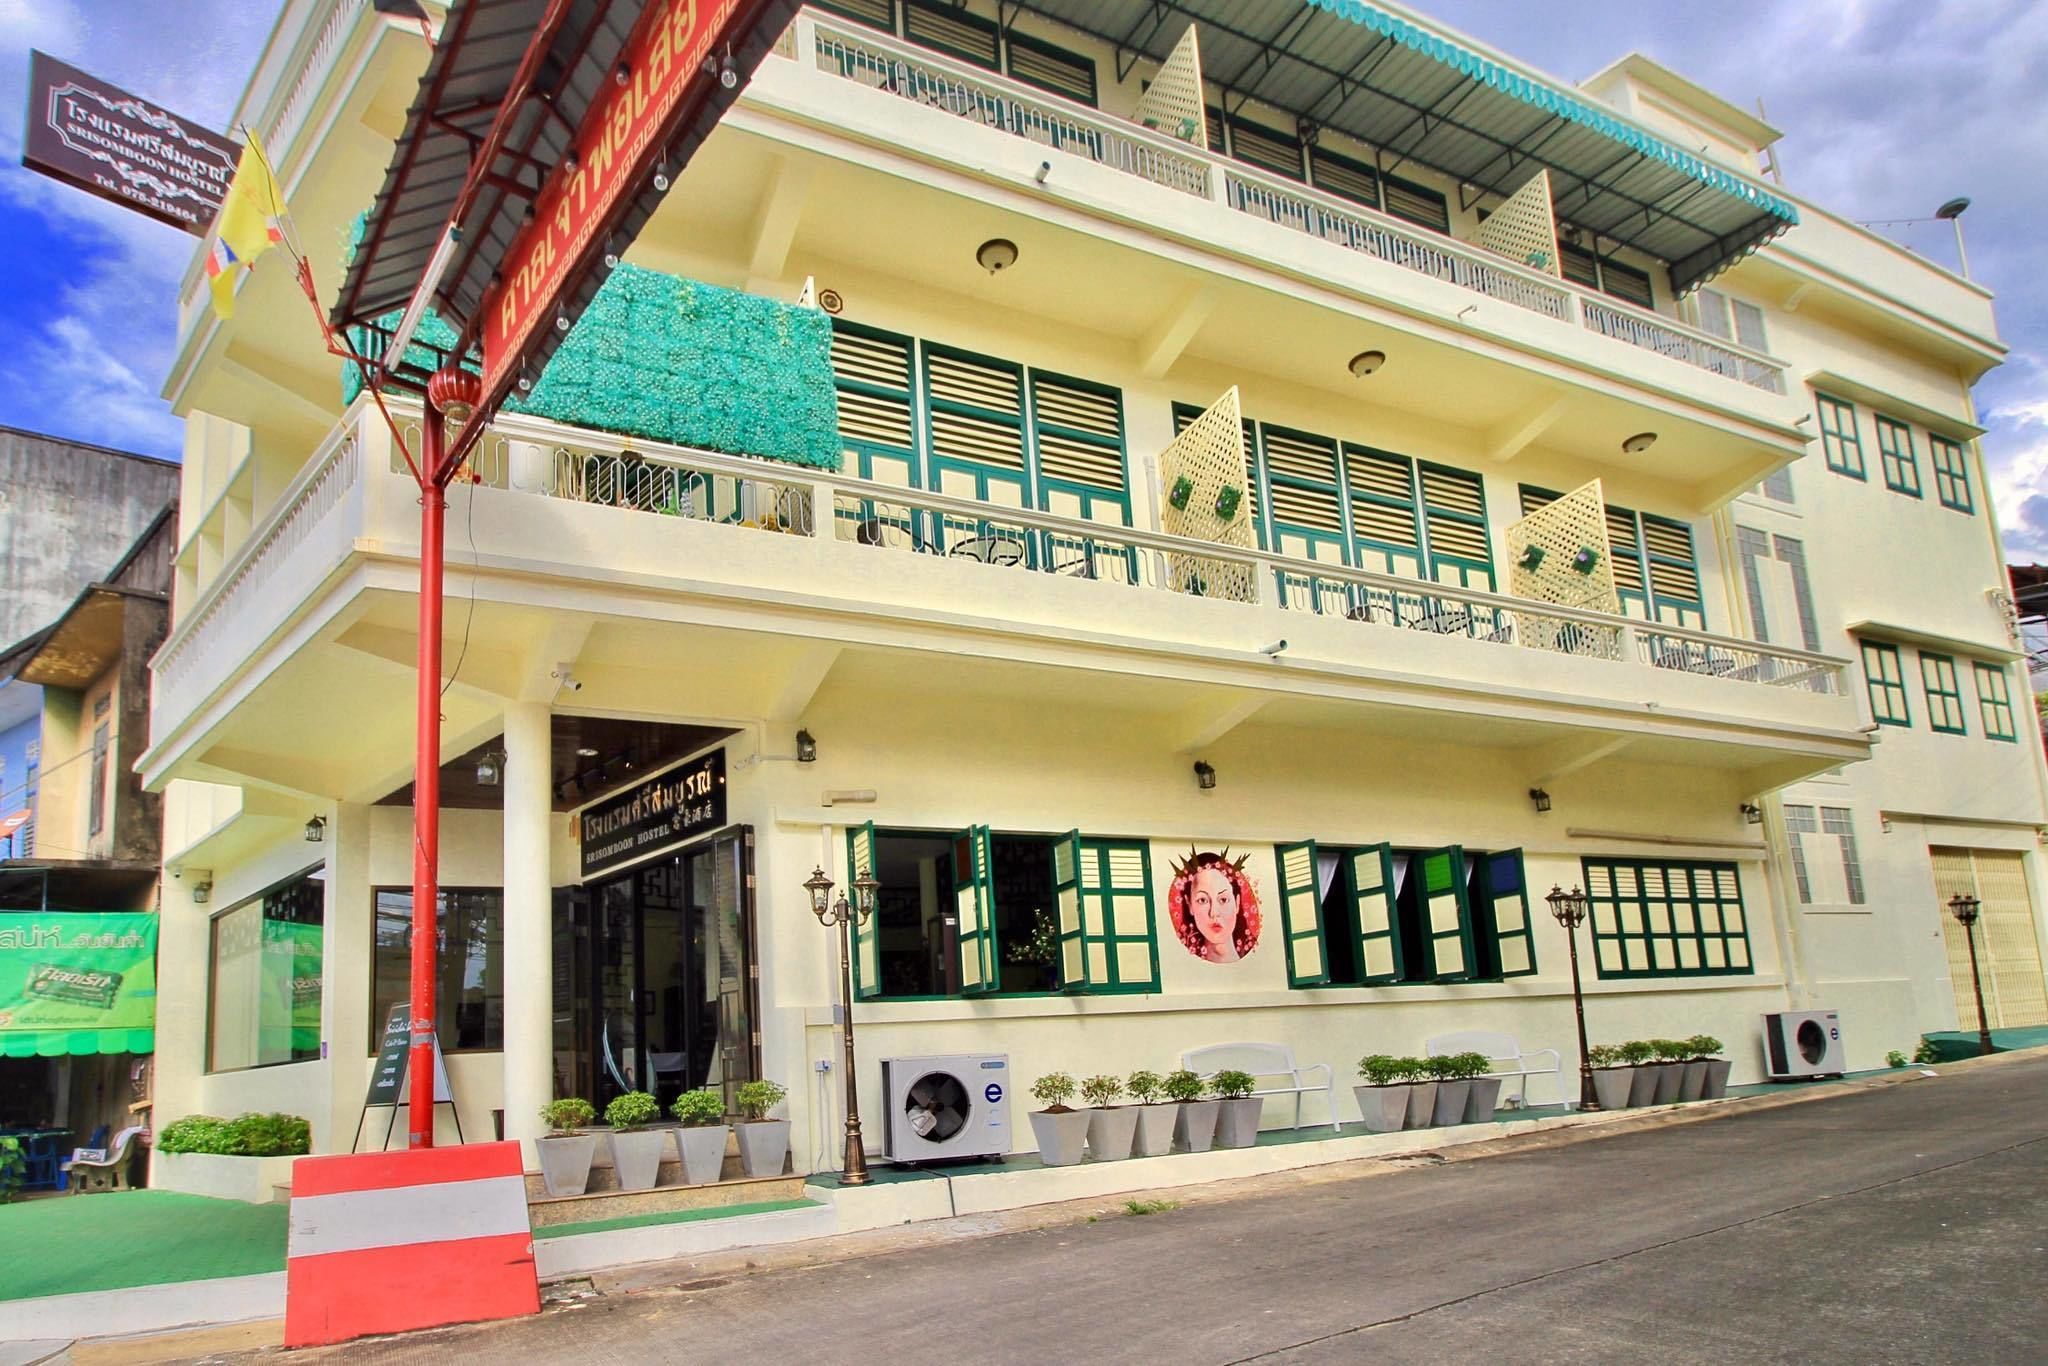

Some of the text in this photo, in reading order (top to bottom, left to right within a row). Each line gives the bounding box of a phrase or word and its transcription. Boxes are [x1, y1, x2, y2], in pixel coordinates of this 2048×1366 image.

[66, 122, 225, 198] SRISOMBOON HOSTEL
[94, 173, 118, 191] Tel.
[583, 758, 713, 841] โรงแรมศรีสมบูรณ์
[586, 824, 670, 864] SRISOMBOON HOSTEL
